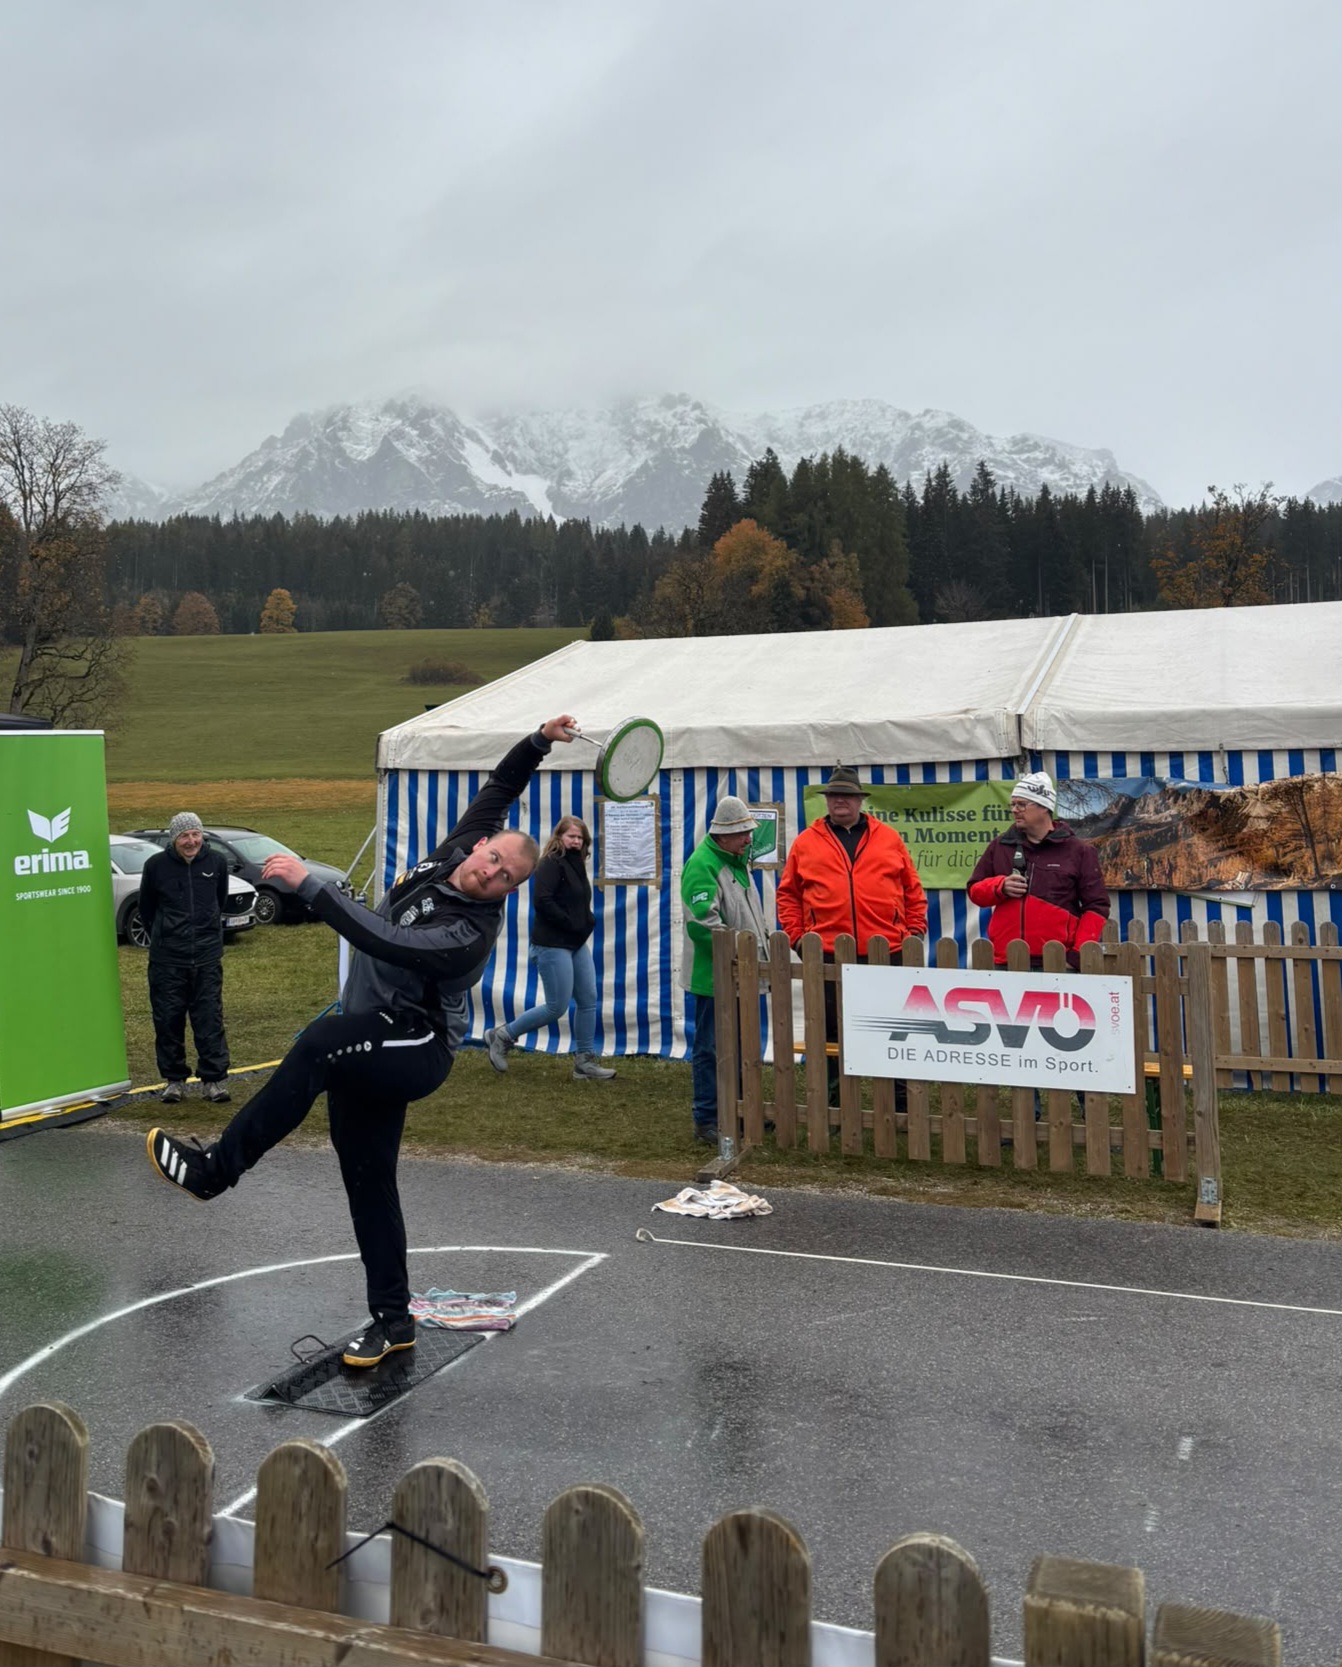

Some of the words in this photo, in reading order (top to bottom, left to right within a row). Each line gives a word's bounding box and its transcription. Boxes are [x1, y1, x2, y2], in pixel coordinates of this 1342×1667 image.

[904, 806, 977, 823] Kulisse
[982, 804, 1012, 822] für
[917, 851, 943, 871] für
[16, 889, 57, 901] SPORTSWEAR
[58, 886, 75, 896] SINCE
[76, 885, 92, 894] 1900
[888, 985, 1096, 1052] ASVÖ
[887, 1047, 917, 1061] DIE
[924, 1049, 1012, 1067] ADRESSE
[1018, 1055, 1038, 1069] im
[1045, 1057, 1099, 1073] Sport.
